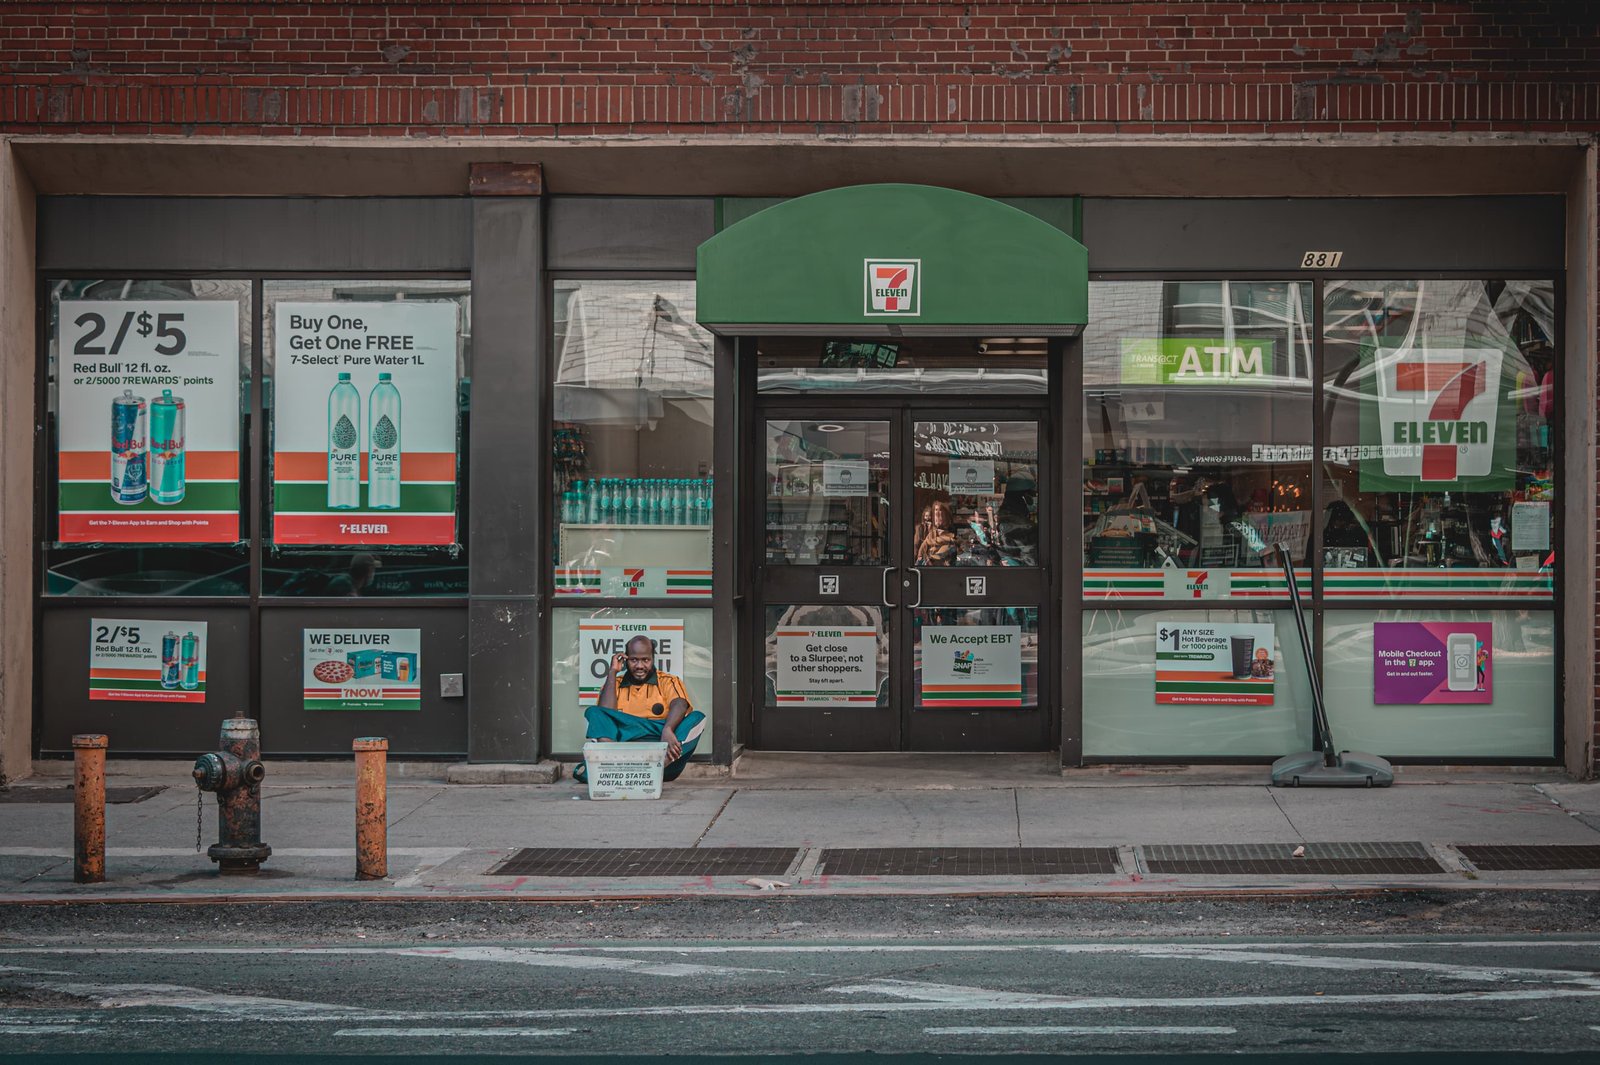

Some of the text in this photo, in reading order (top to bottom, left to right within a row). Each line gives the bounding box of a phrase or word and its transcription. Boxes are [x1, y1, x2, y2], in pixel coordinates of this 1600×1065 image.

[1304, 253, 1337, 267] 881
[877, 268, 907, 310] 7
[290, 315, 368, 333] Buy One,
[74, 311, 187, 356] 2/$5
[290, 335, 413, 350] Get One FREE
[344, 355, 371, 365] Pure
[374, 355, 409, 365] Water
[411, 355, 424, 365] 1L
[1177, 346, 1263, 377] ATM
[74, 363, 96, 373] Red
[125, 363, 138, 373] 12
[140, 363, 151, 373] fl.
[154, 364, 171, 373] oz.
[74, 377, 83, 385] or
[86, 376, 120, 385] 2/5000
[183, 376, 213, 387] points
[1396, 360, 1486, 480] 7
[330, 453, 357, 461] PURE
[371, 453, 398, 461] PURE
[96, 626, 140, 644] 2/$5
[310, 634, 390, 644] WE DELIVER
[929, 634, 1013, 645] We Accept EBT
[1160, 628, 1180, 651] $1
[591, 639, 624, 654] WE
[806, 644, 848, 652] Get close
[790, 654, 799, 662] to
[848, 654, 863, 662] not
[791, 664, 862, 674] other shoppers.
[954, 662, 972, 670] SNAP
[343, 689, 380, 698] 7NOW
